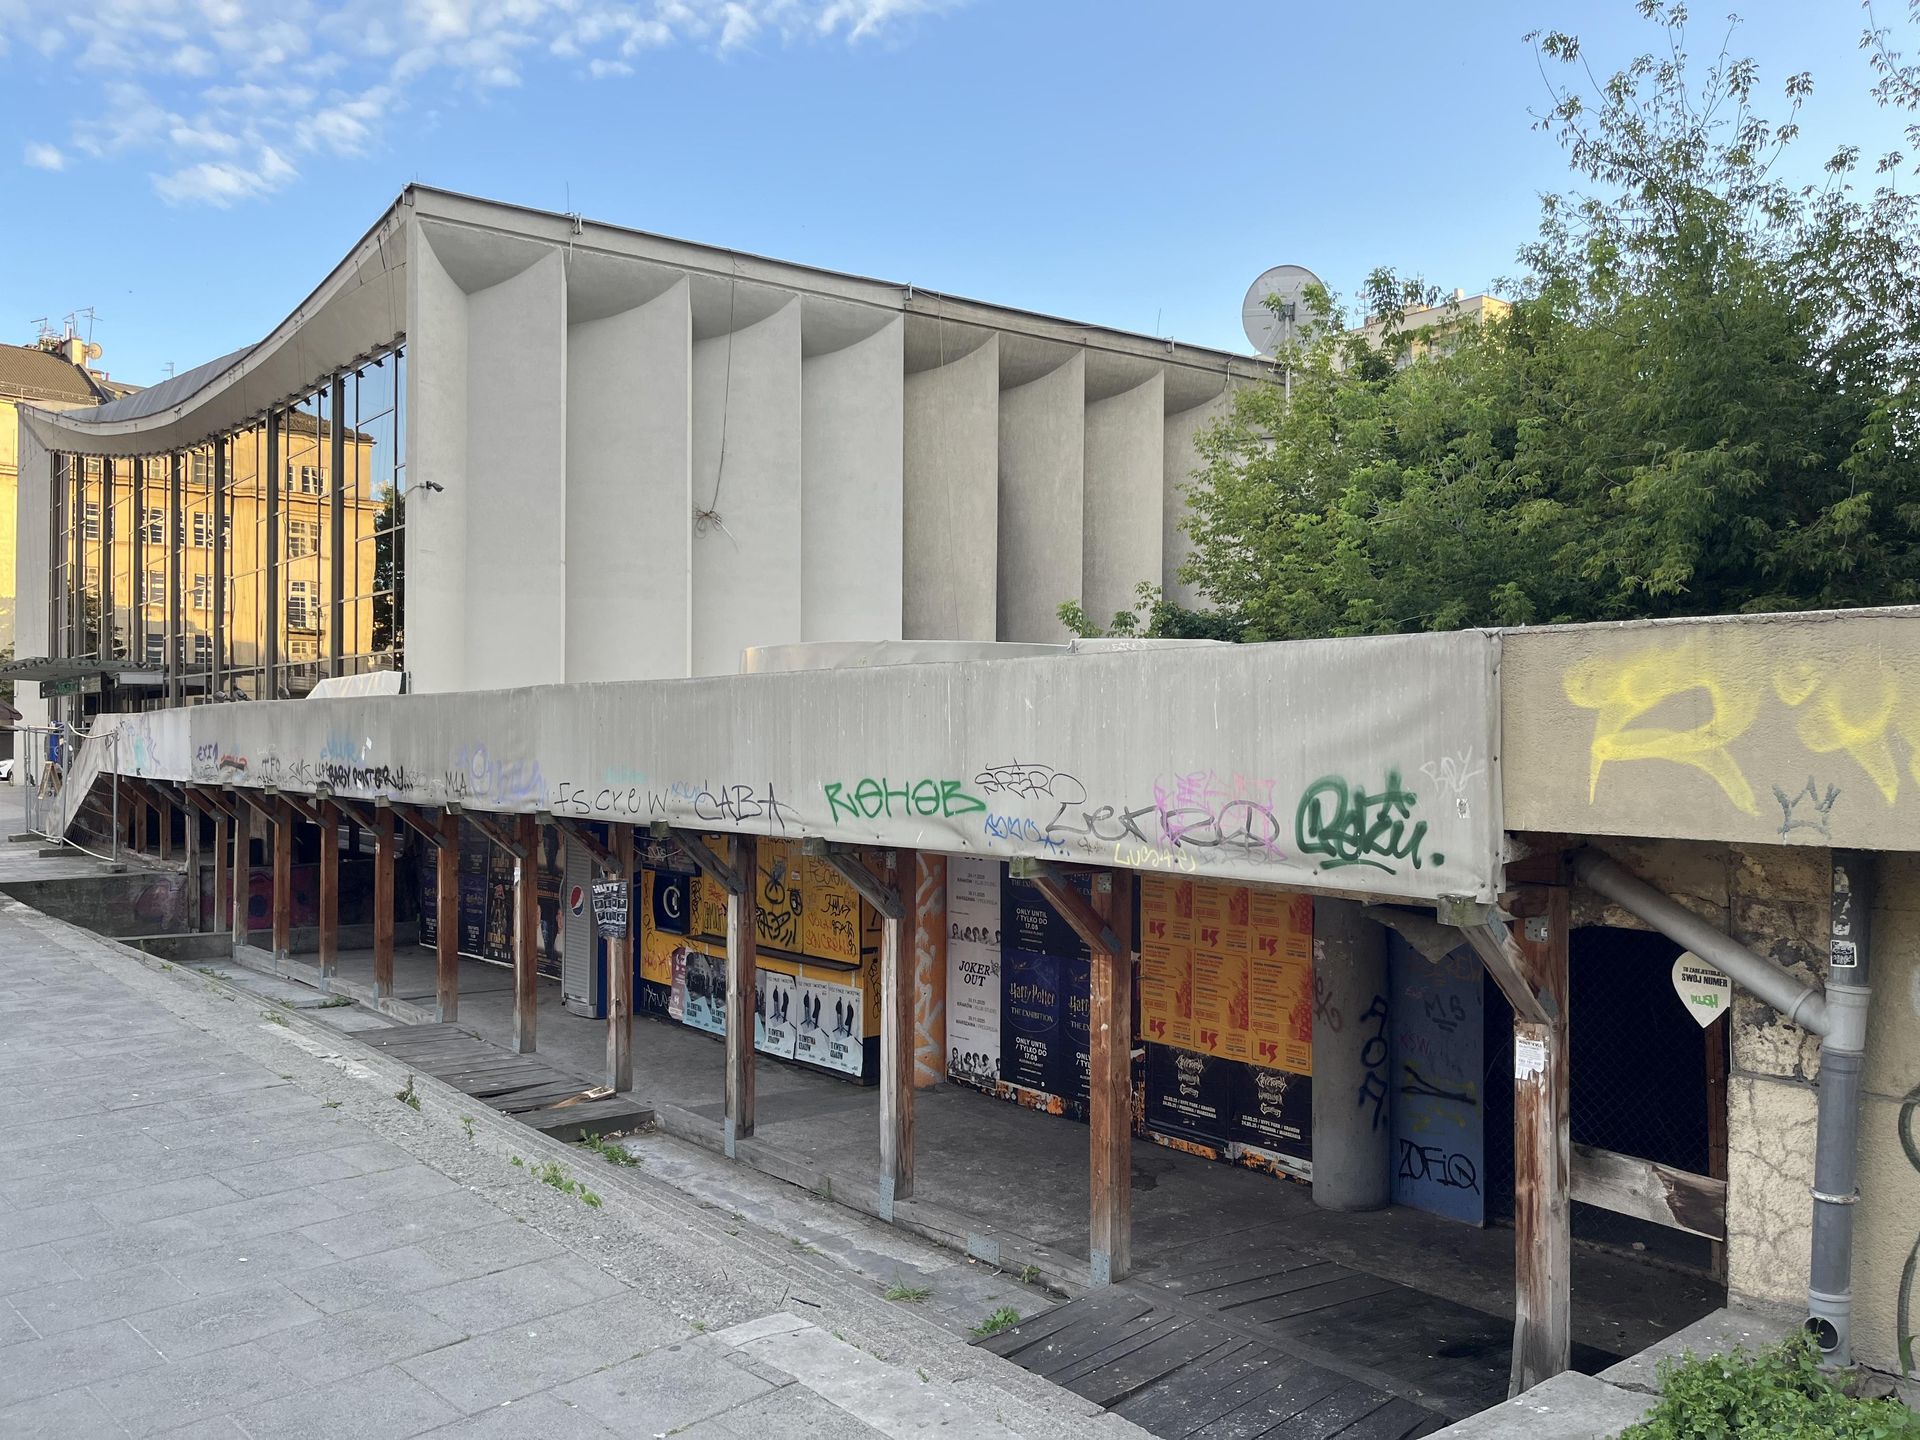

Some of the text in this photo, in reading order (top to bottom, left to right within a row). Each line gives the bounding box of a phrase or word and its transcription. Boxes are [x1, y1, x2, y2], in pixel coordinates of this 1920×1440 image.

[1016, 908, 1047, 918] ONLY UNTIL
[1020, 915, 1037, 924] TYLKO
[958, 960, 990, 976] JOKER
[964, 974, 986, 987] OUT
[1682, 973, 1728, 988] SWÓJ NUMER
[1009, 982, 1056, 1008] Harry Potter
[1010, 1006, 1054, 1022] THE EXHIBITION
[1016, 1036, 1047, 1050] ONLY UNTIL
[1019, 1044, 1037, 1056] TYLKO
